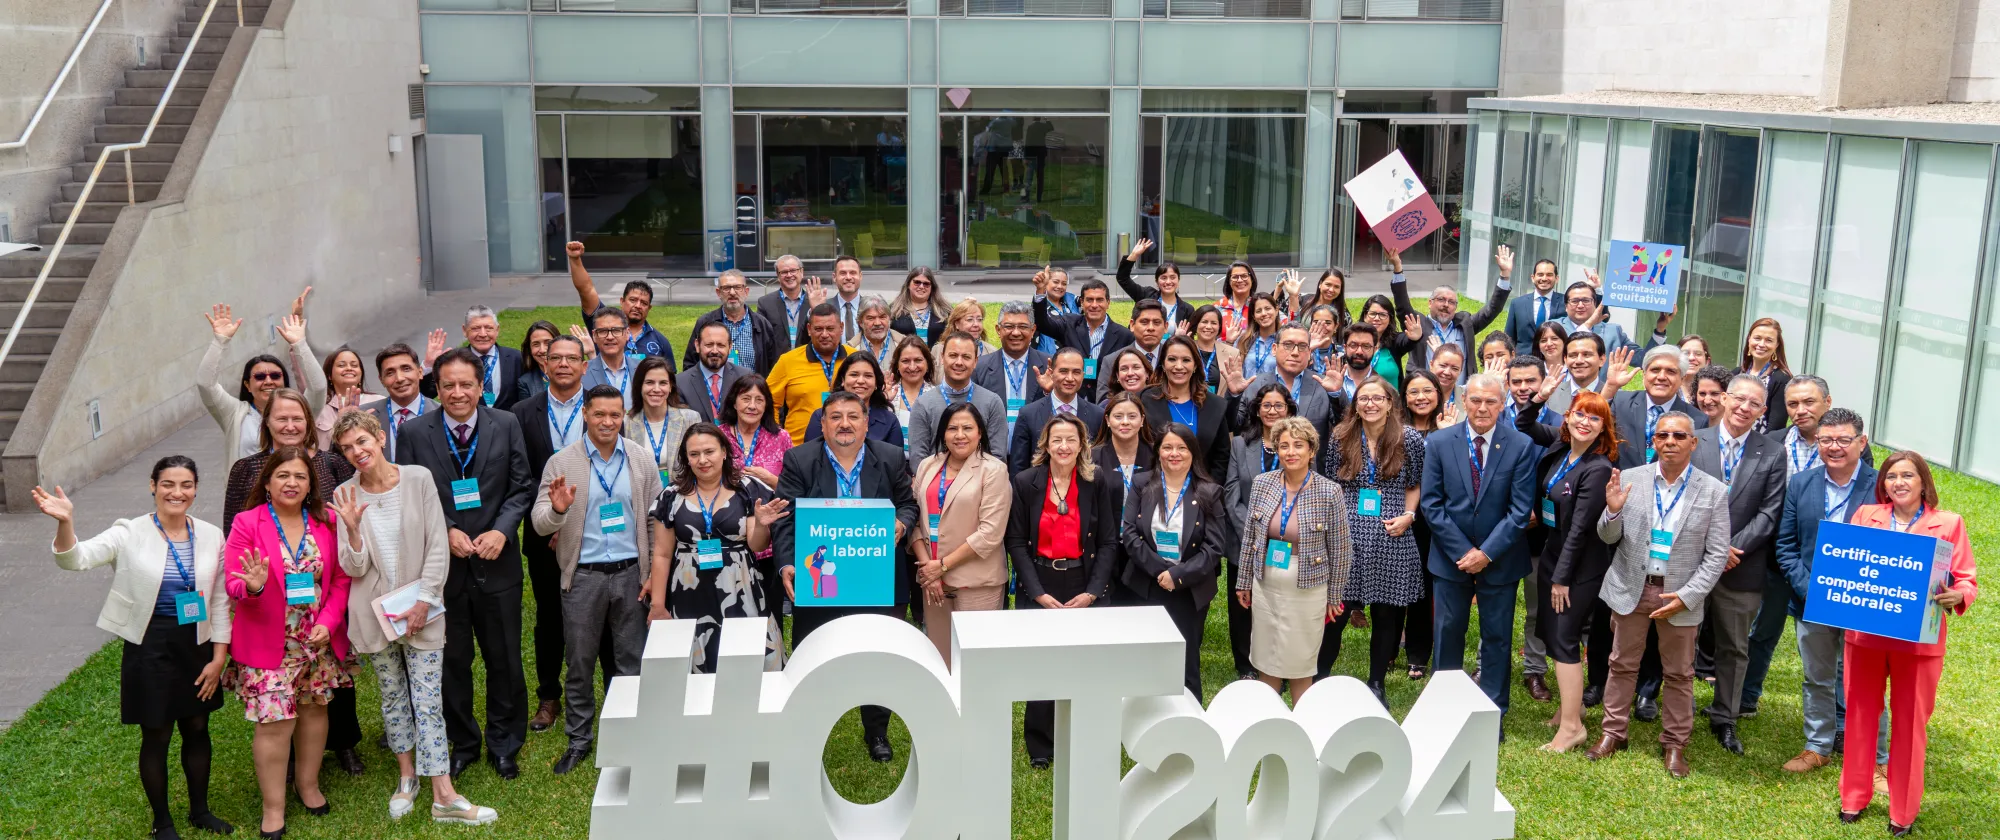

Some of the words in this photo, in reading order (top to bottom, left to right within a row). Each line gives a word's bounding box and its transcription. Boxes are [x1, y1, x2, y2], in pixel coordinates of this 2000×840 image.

[1611, 282, 1669, 295] Contratación
[1610, 292, 1667, 305] equitativa
[809, 523, 887, 540] Migración
[833, 544, 887, 557] laboral
[1821, 543, 1923, 571] Certificación
[1859, 565, 1880, 579] de
[1816, 575, 1918, 601] competencias
[1826, 588, 1903, 614] laborales
